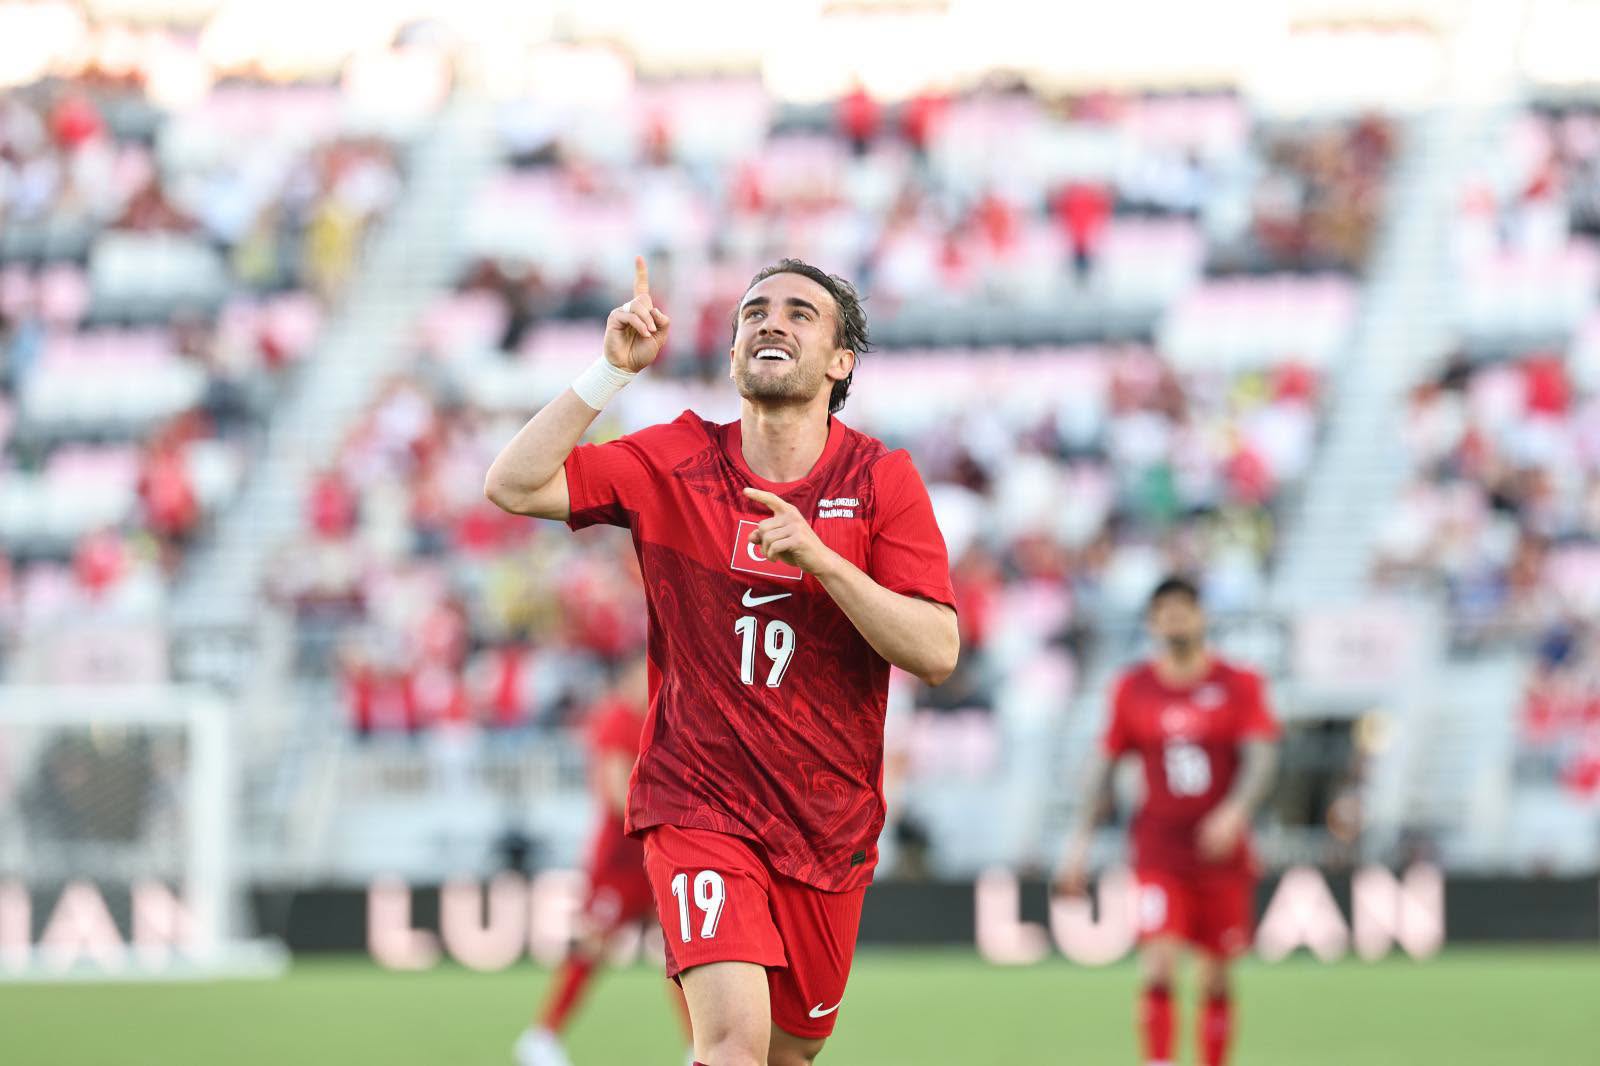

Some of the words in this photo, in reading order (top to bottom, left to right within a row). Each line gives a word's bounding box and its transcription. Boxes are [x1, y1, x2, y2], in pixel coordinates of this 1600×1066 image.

[734, 615, 796, 688] 19
[671, 869, 726, 943] 19
[974, 864, 1447, 966] LUAN
